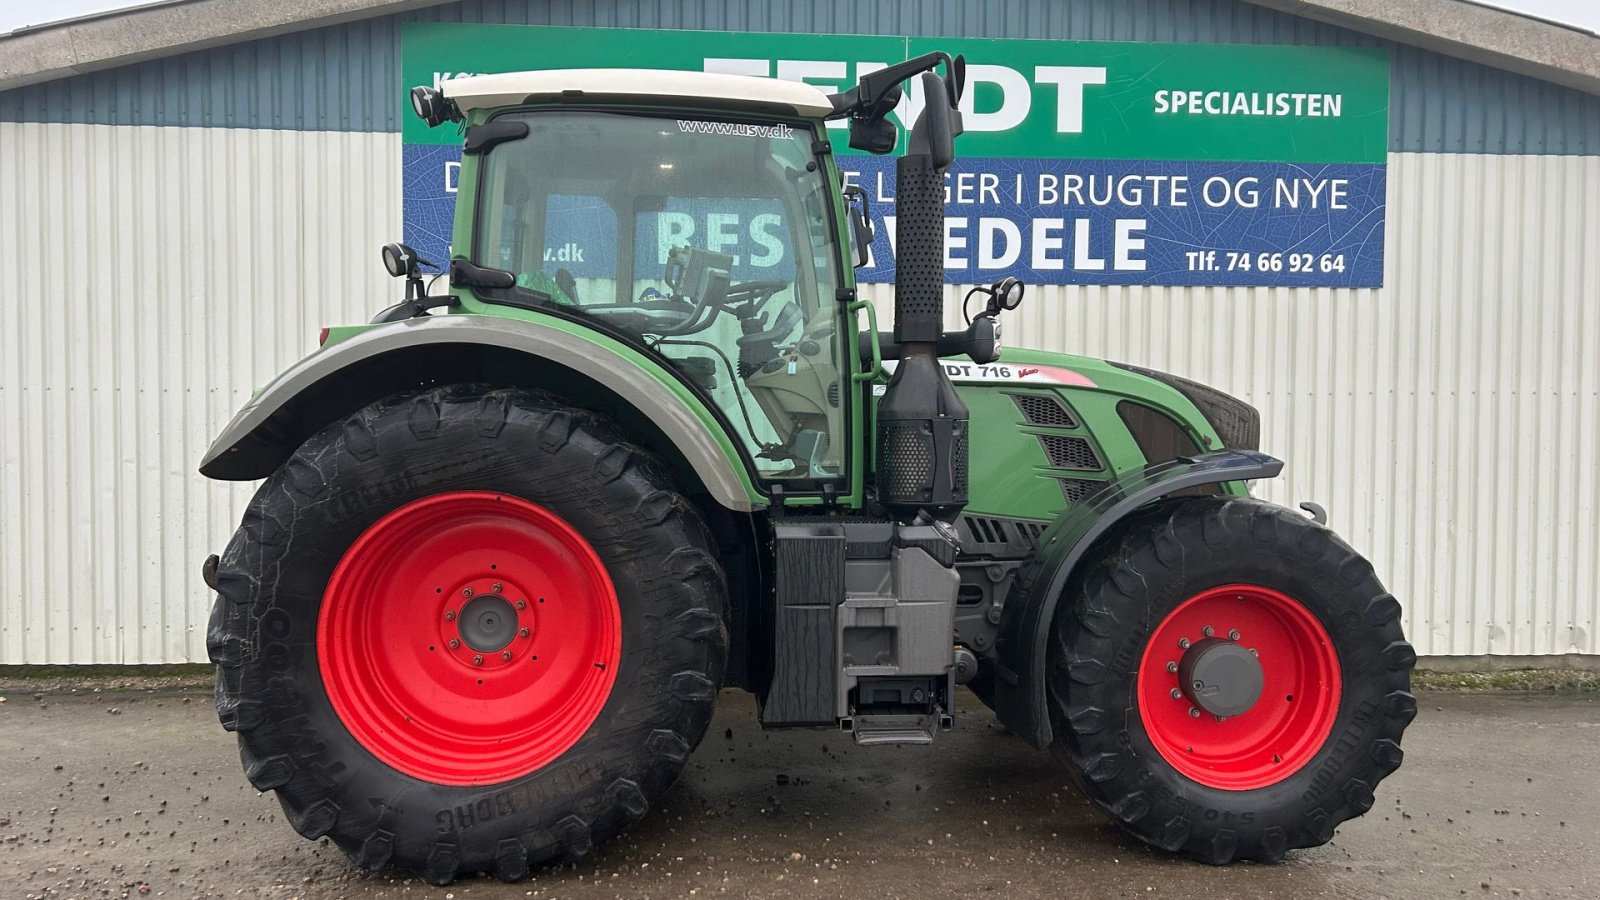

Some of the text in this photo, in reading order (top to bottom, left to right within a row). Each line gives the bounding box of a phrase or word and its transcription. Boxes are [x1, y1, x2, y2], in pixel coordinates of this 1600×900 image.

[1154, 90, 1342, 117] SPECIALISTEN
[677, 120, 793, 140] www.usv.dk
[877, 171, 1000, 204] LER
[1016, 174, 1023, 204] I
[1039, 173, 1188, 207] BRUGTE
[1202, 176, 1259, 208] OG
[1275, 178, 1348, 210] NYE
[1186, 251, 1346, 273] Tlf. 74 66 92 64
[978, 366, 1011, 378] 716
